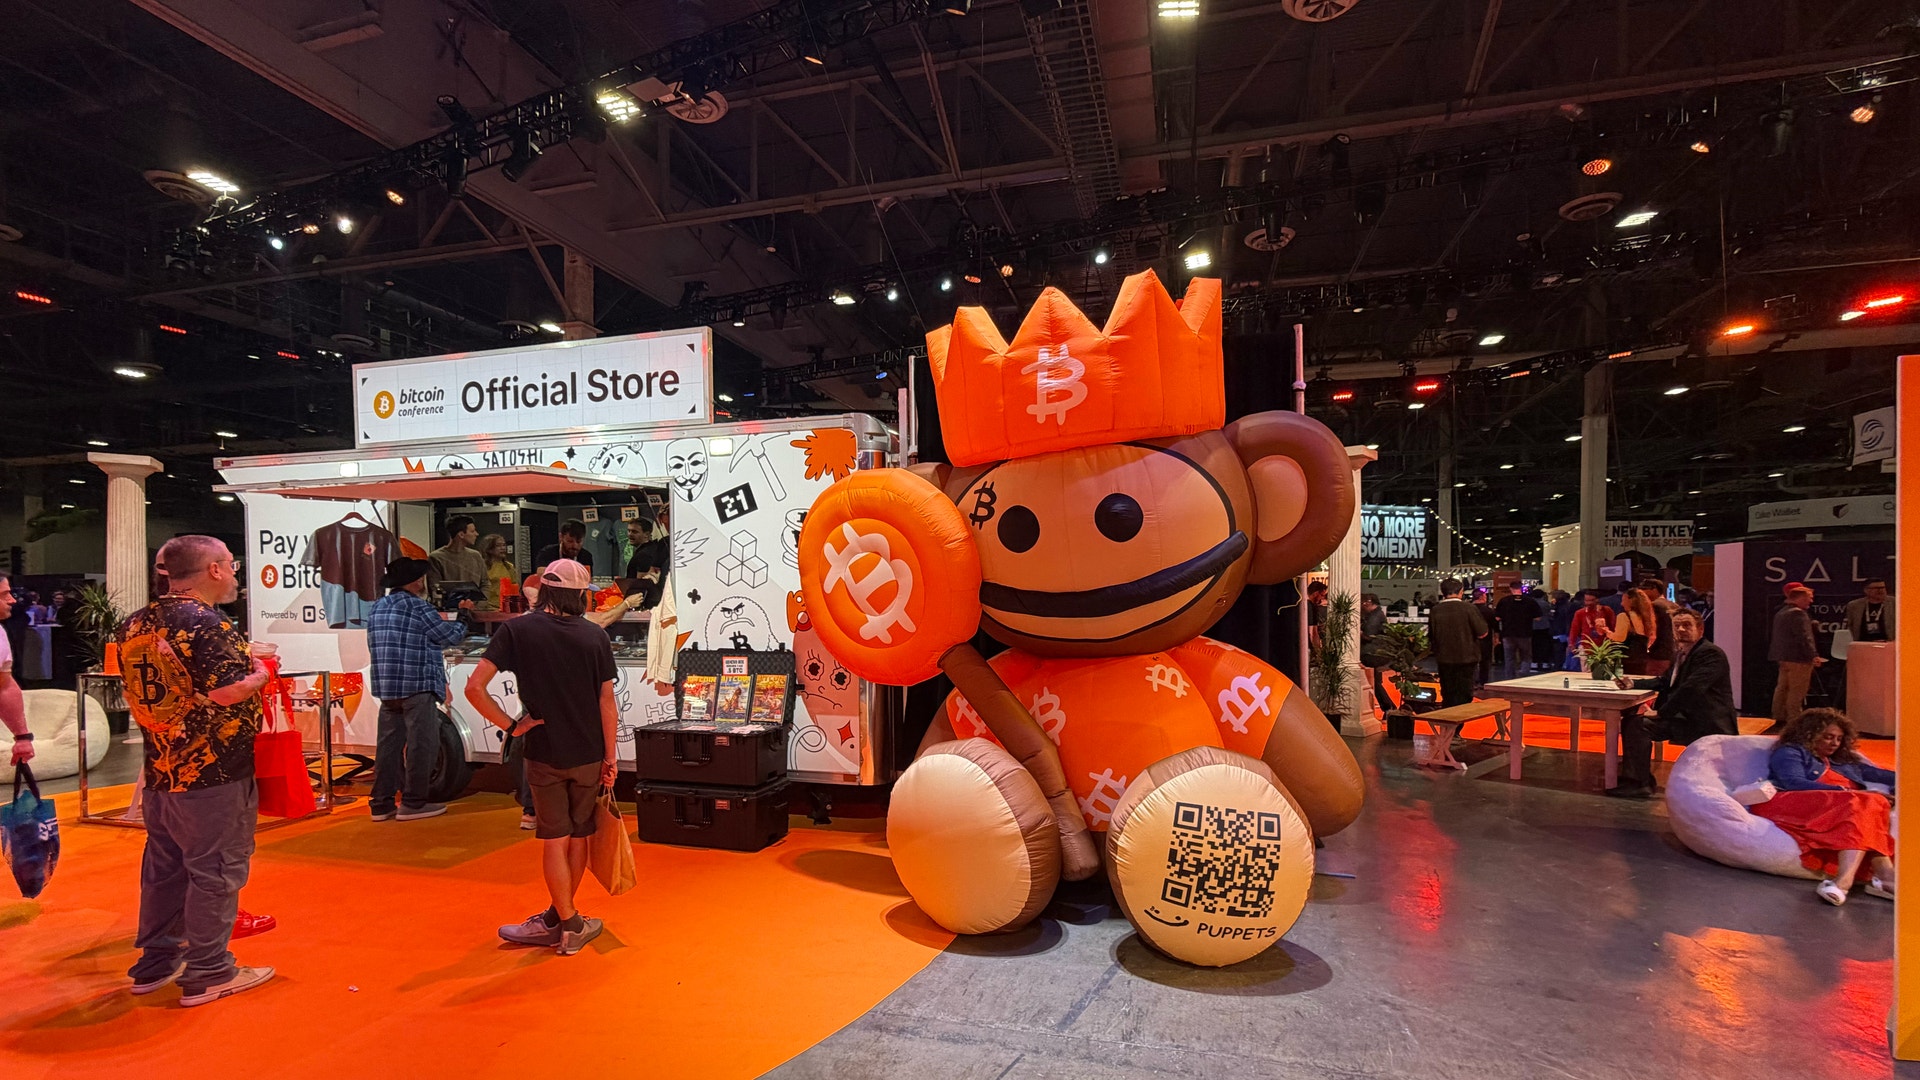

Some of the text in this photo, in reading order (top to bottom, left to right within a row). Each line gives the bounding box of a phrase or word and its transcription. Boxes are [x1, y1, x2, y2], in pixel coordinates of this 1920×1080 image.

[399, 386, 444, 405] bitcoin
[461, 368, 680, 413] Official Store
[398, 405, 444, 418] conference
[483, 449, 542, 468] SATOSHI
[720, 489, 749, 518] 21
[1361, 516, 1425, 538] NO MORE
[1612, 525, 1694, 538] NEW BITKEY
[260, 530, 298, 560] Pay
[1361, 537, 1427, 559] SOMEDAY
[261, 610, 289, 619] Powered
[290, 610, 298, 621] by
[1812, 604, 1829, 614] TO
[1197, 922, 1276, 940] PUPPETS
